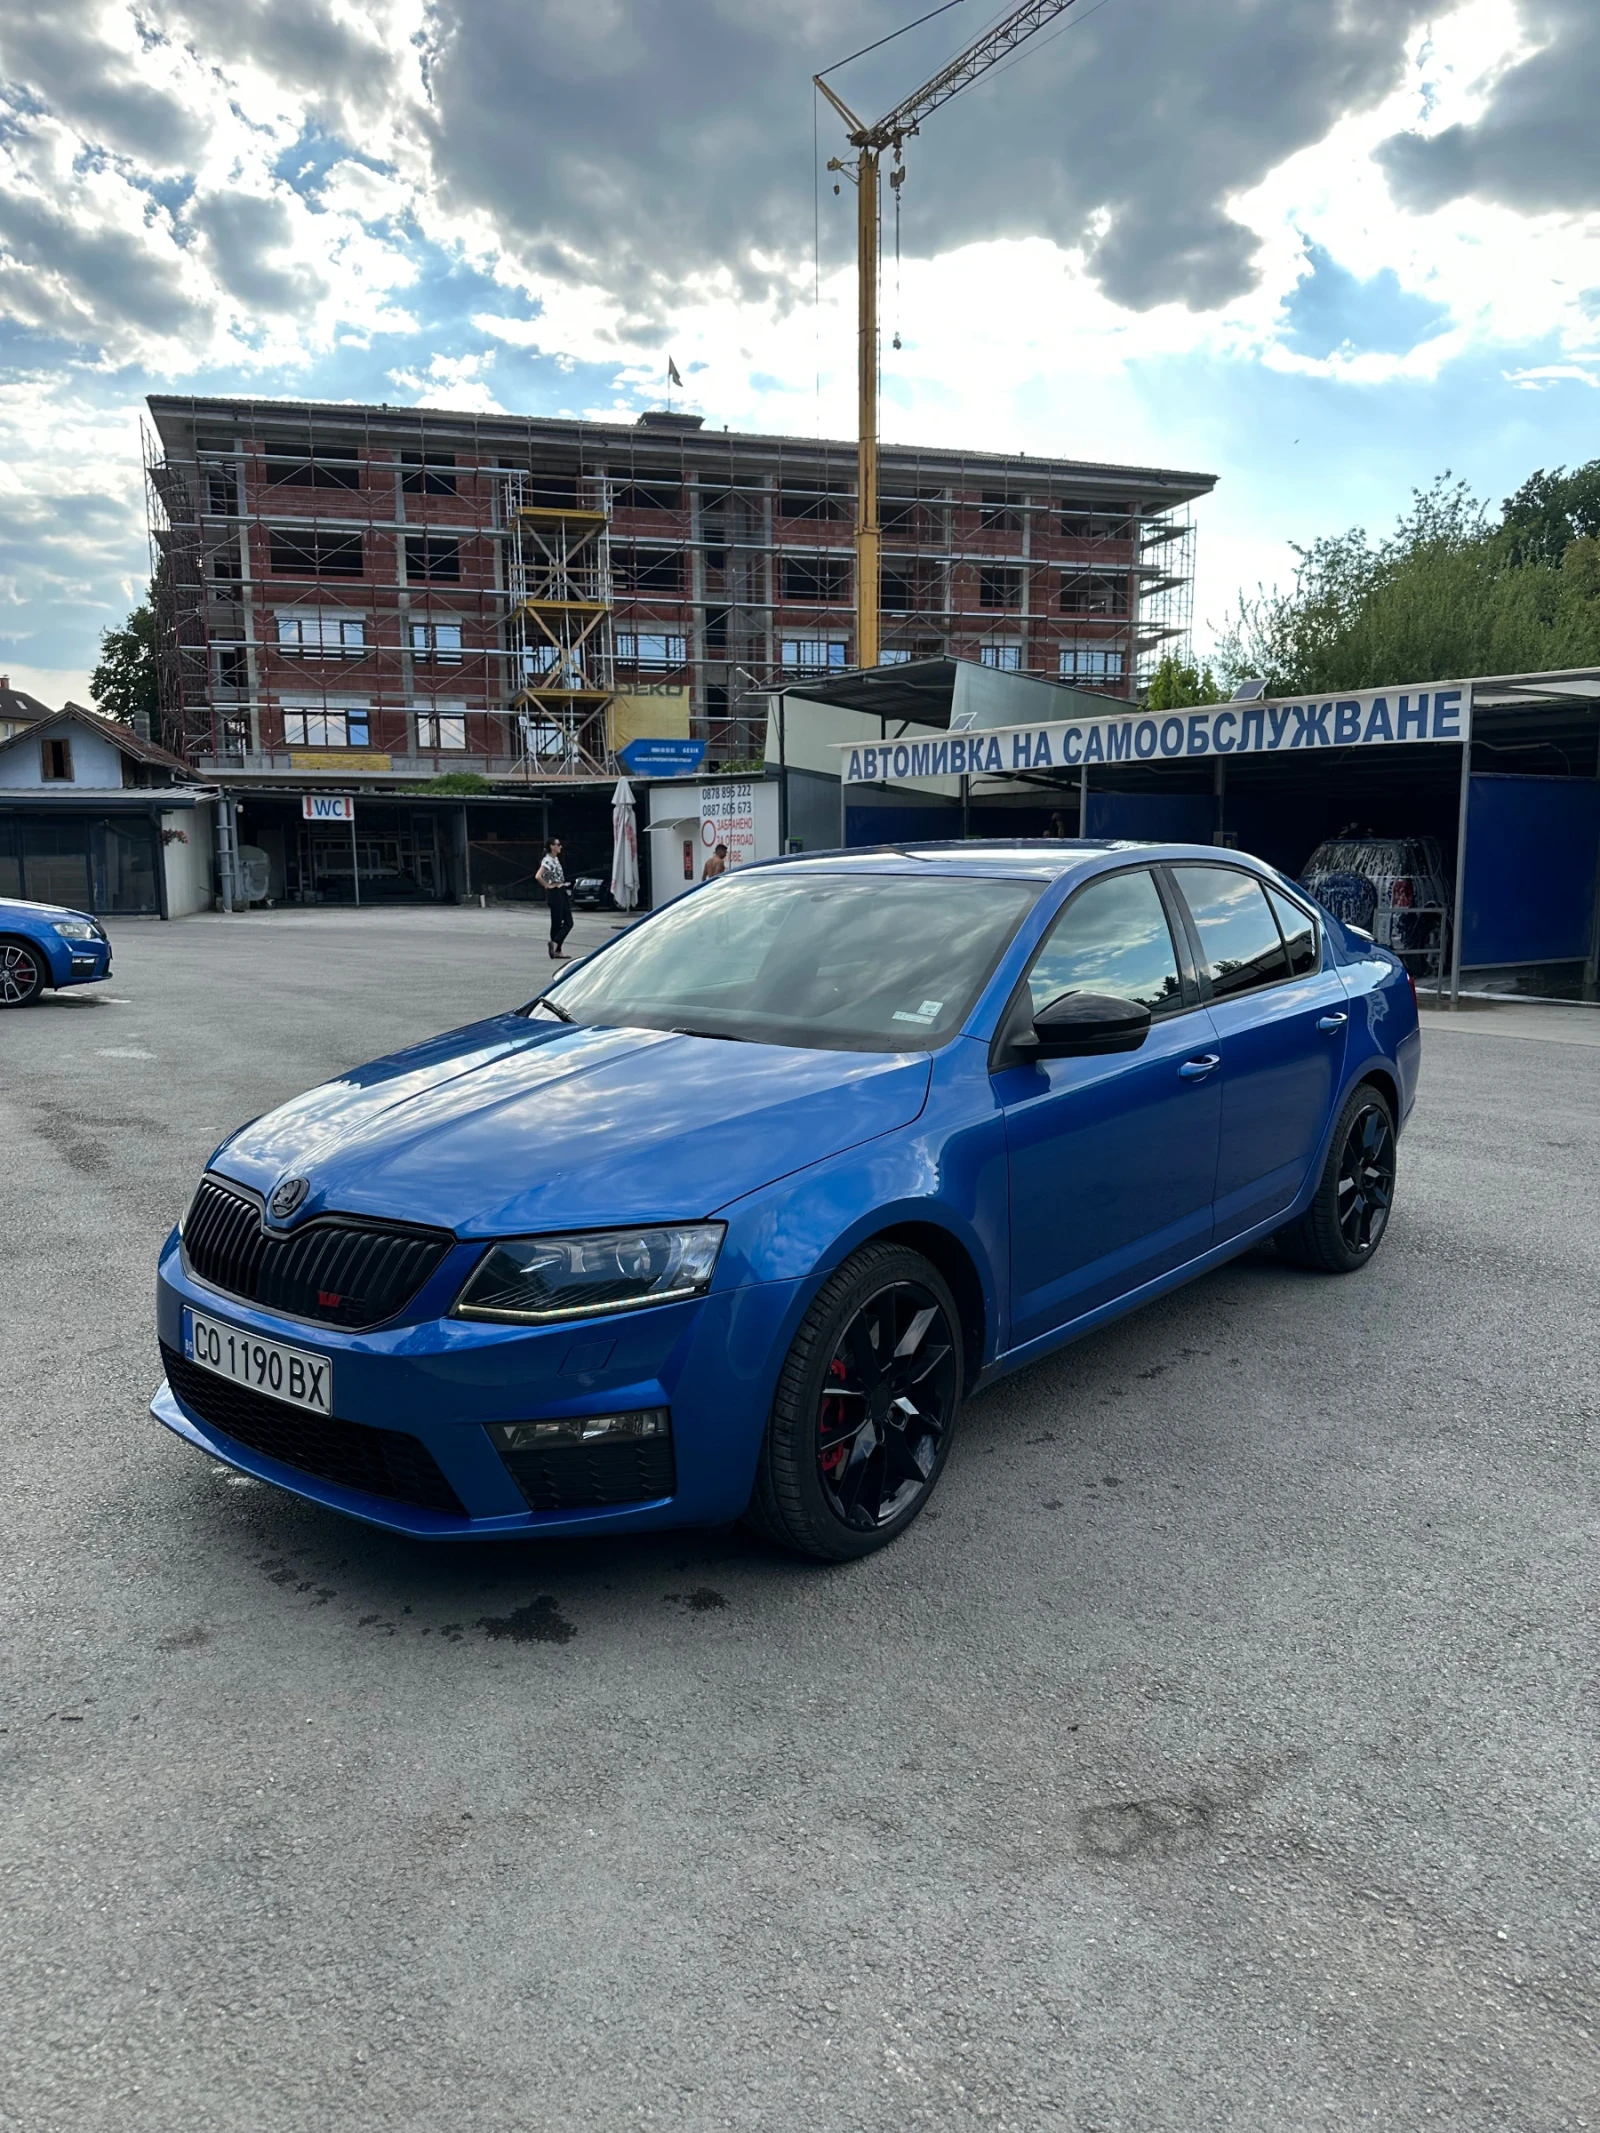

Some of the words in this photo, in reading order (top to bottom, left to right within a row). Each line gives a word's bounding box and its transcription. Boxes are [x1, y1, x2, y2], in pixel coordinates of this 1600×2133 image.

[847, 736, 1003, 781] АВТОМИВКА
[1013, 731, 1052, 769] НА
[1063, 690, 1462, 764] САМООБСЛУЖВАНЕ
[702, 787, 720, 800] 0878
[722, 785, 735, 798] 895
[737, 784, 751, 796] 222
[314, 799, 342, 816] WC
[702, 804, 720, 816] 0887
[738, 801, 751, 813] 673
[717, 817, 752, 831] ЗАБРАНЕНО
[195, 1321, 220, 1366] CO
[228, 1335, 283, 1391] 1190
[289, 1355, 325, 1407] BX
